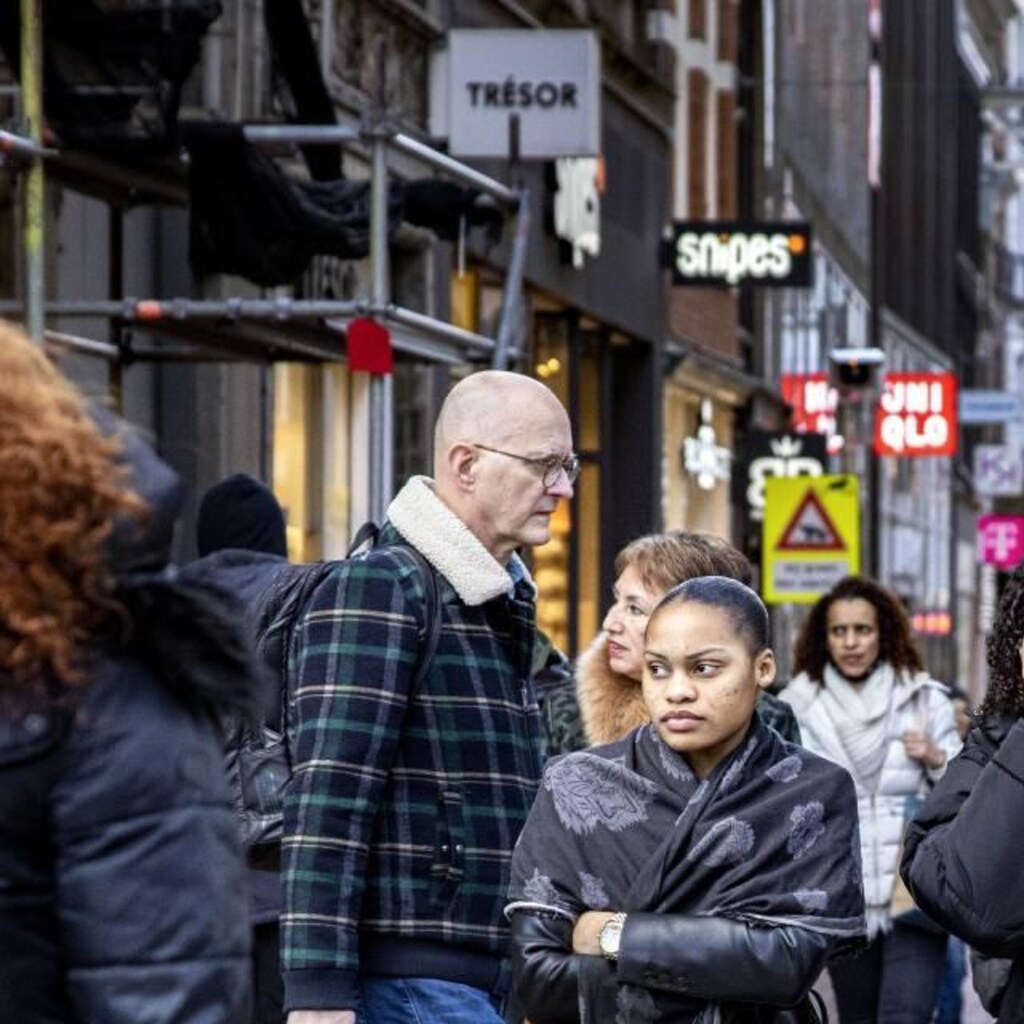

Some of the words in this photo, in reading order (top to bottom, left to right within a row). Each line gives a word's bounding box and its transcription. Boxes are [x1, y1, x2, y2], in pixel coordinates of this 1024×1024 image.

[466, 73, 577, 108] TRÉSOR
[676, 232, 792, 284] snipes
[880, 413, 948, 454] QLO
